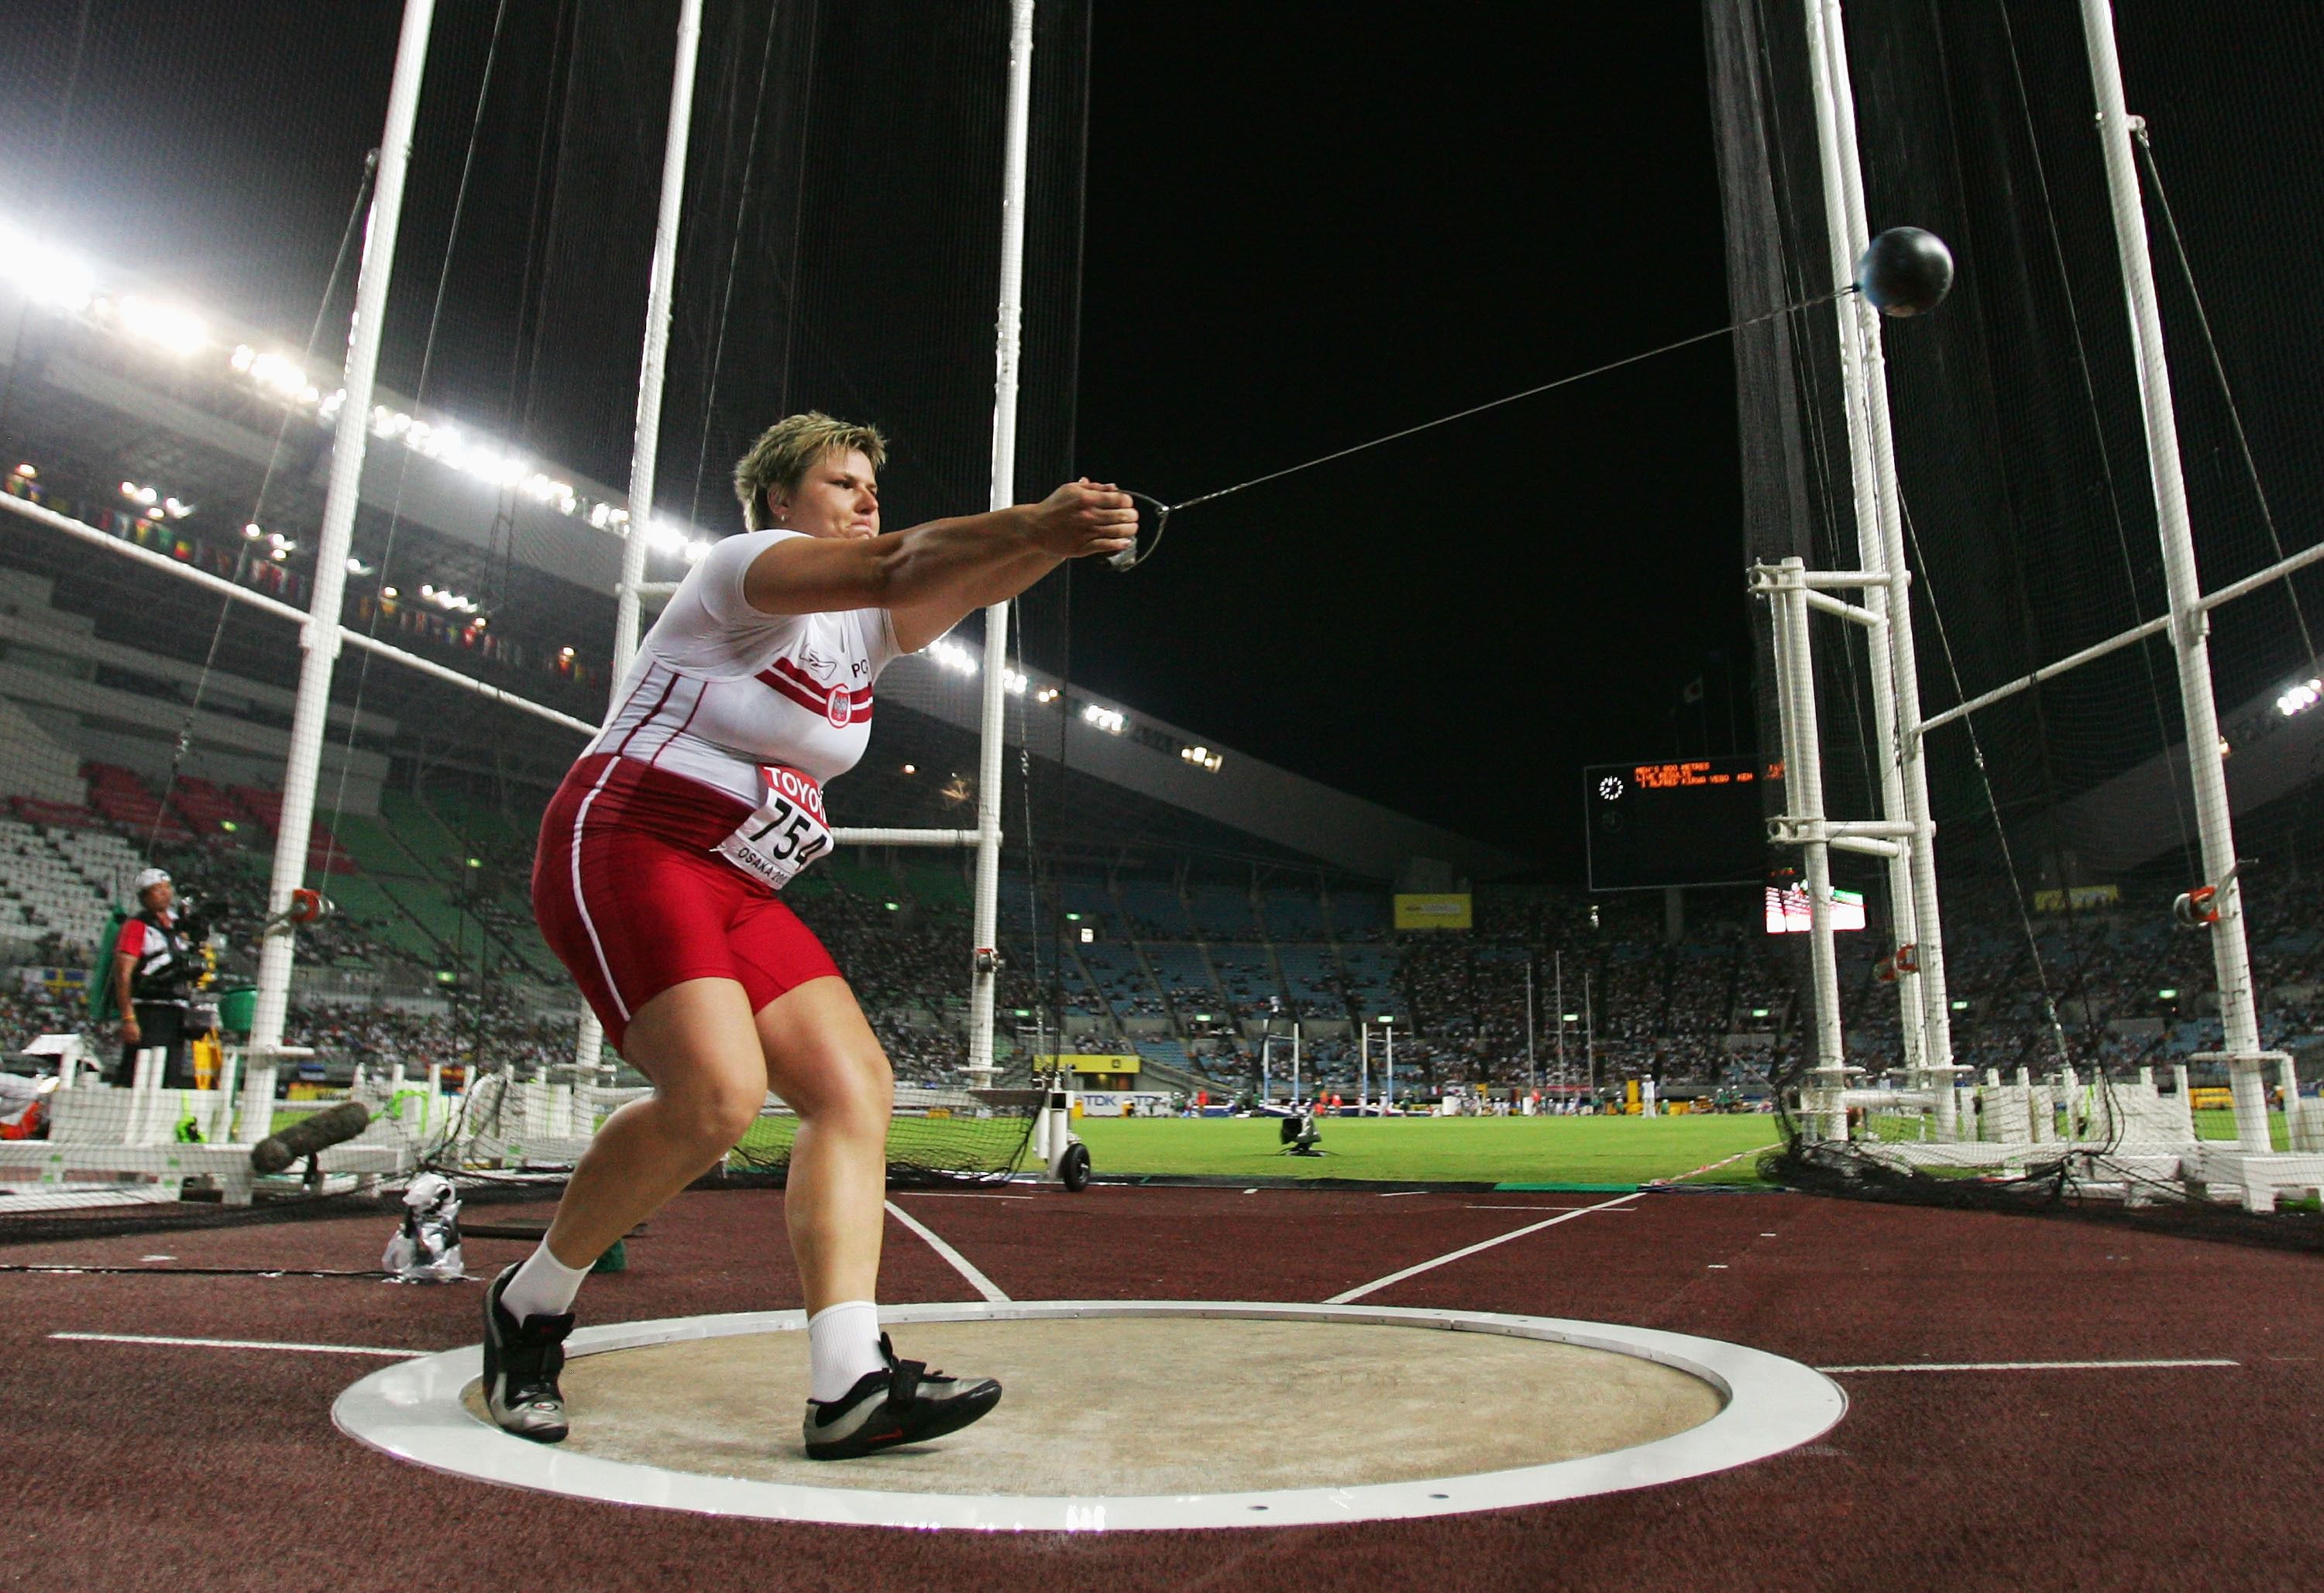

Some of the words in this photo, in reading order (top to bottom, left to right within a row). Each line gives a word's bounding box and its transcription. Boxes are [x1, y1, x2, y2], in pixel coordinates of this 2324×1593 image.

[748, 798, 827, 864] 754
[738, 847, 774, 877] OSAKA
[1084, 1094, 1117, 1106] TDK
